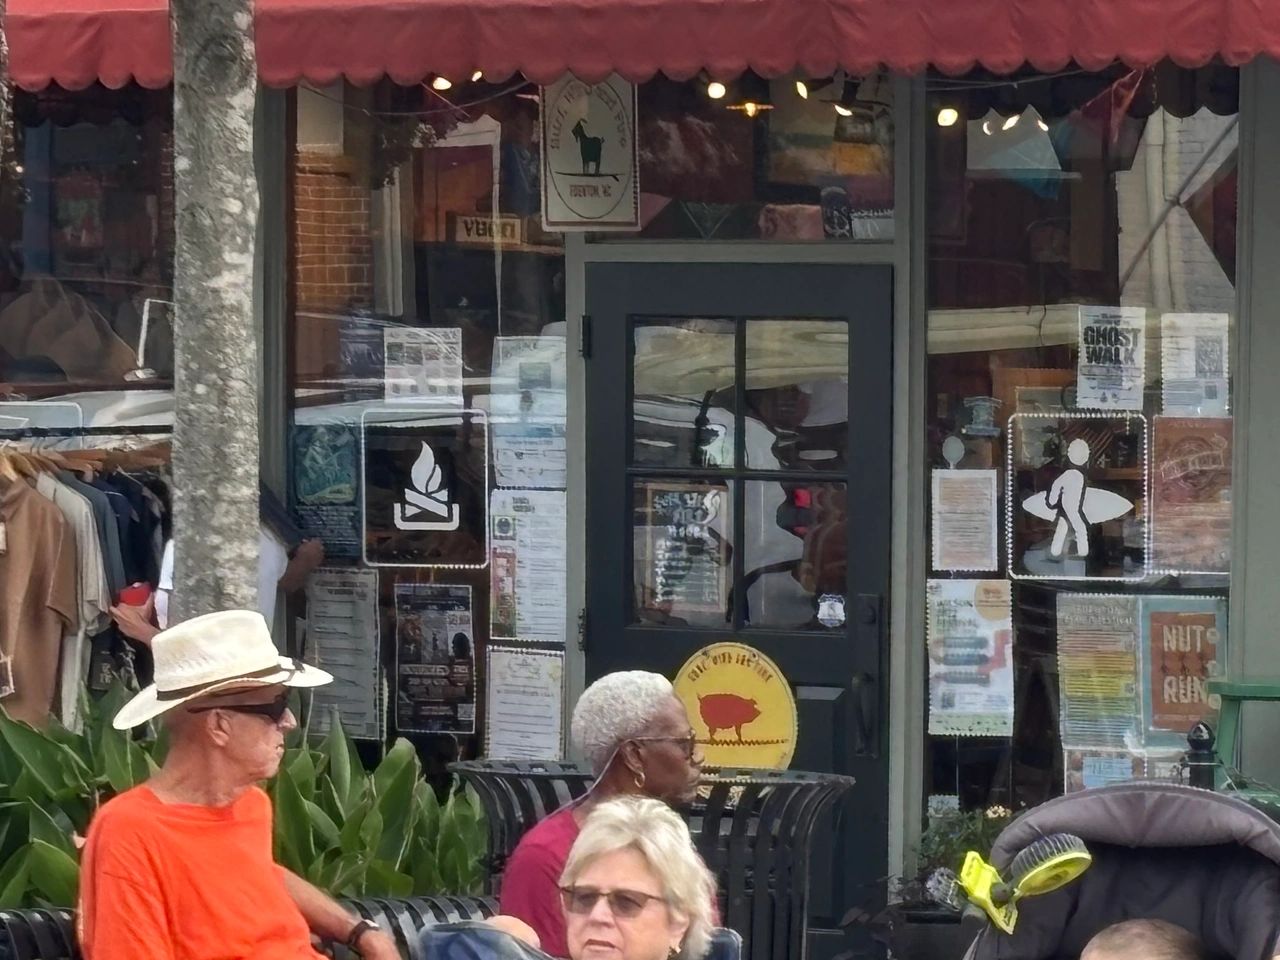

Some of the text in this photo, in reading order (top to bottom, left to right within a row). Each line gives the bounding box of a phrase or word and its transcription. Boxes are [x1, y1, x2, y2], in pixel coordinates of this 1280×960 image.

[1083, 325, 1142, 348] GHOST
[1085, 345, 1137, 365] WALK
[1163, 675, 1208, 705] RUN
